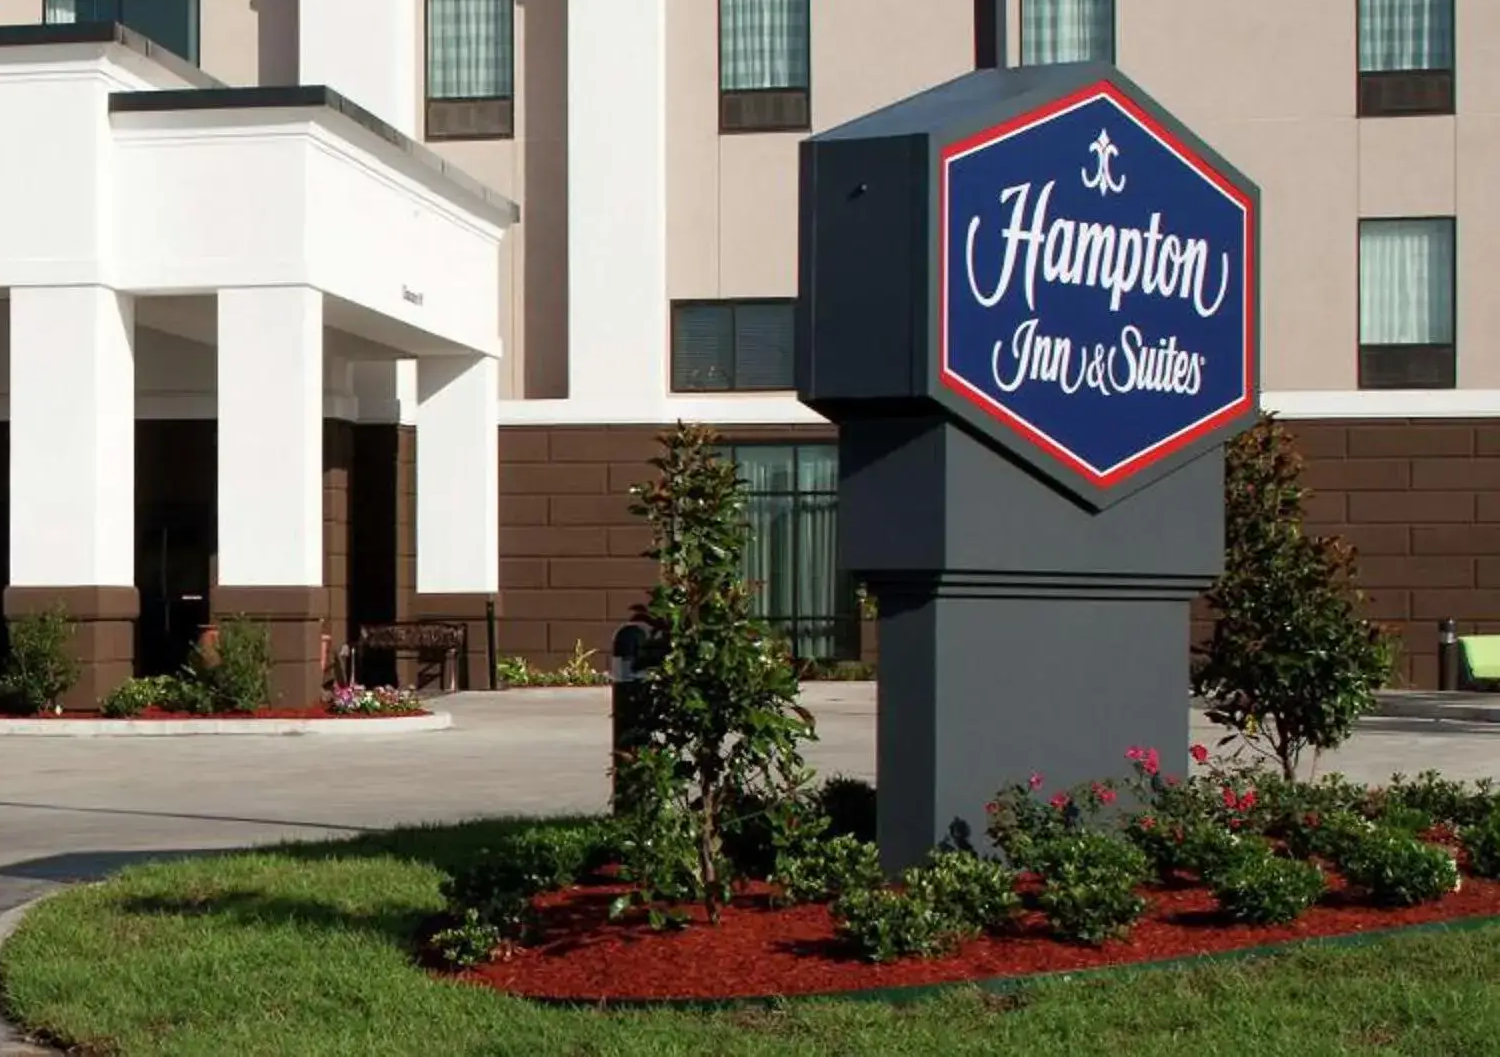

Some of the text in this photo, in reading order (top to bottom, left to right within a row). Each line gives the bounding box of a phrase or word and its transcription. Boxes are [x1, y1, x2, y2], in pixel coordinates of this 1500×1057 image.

[965, 180, 1230, 319] Hampton
[991, 318, 1202, 396] Inn & Suites
